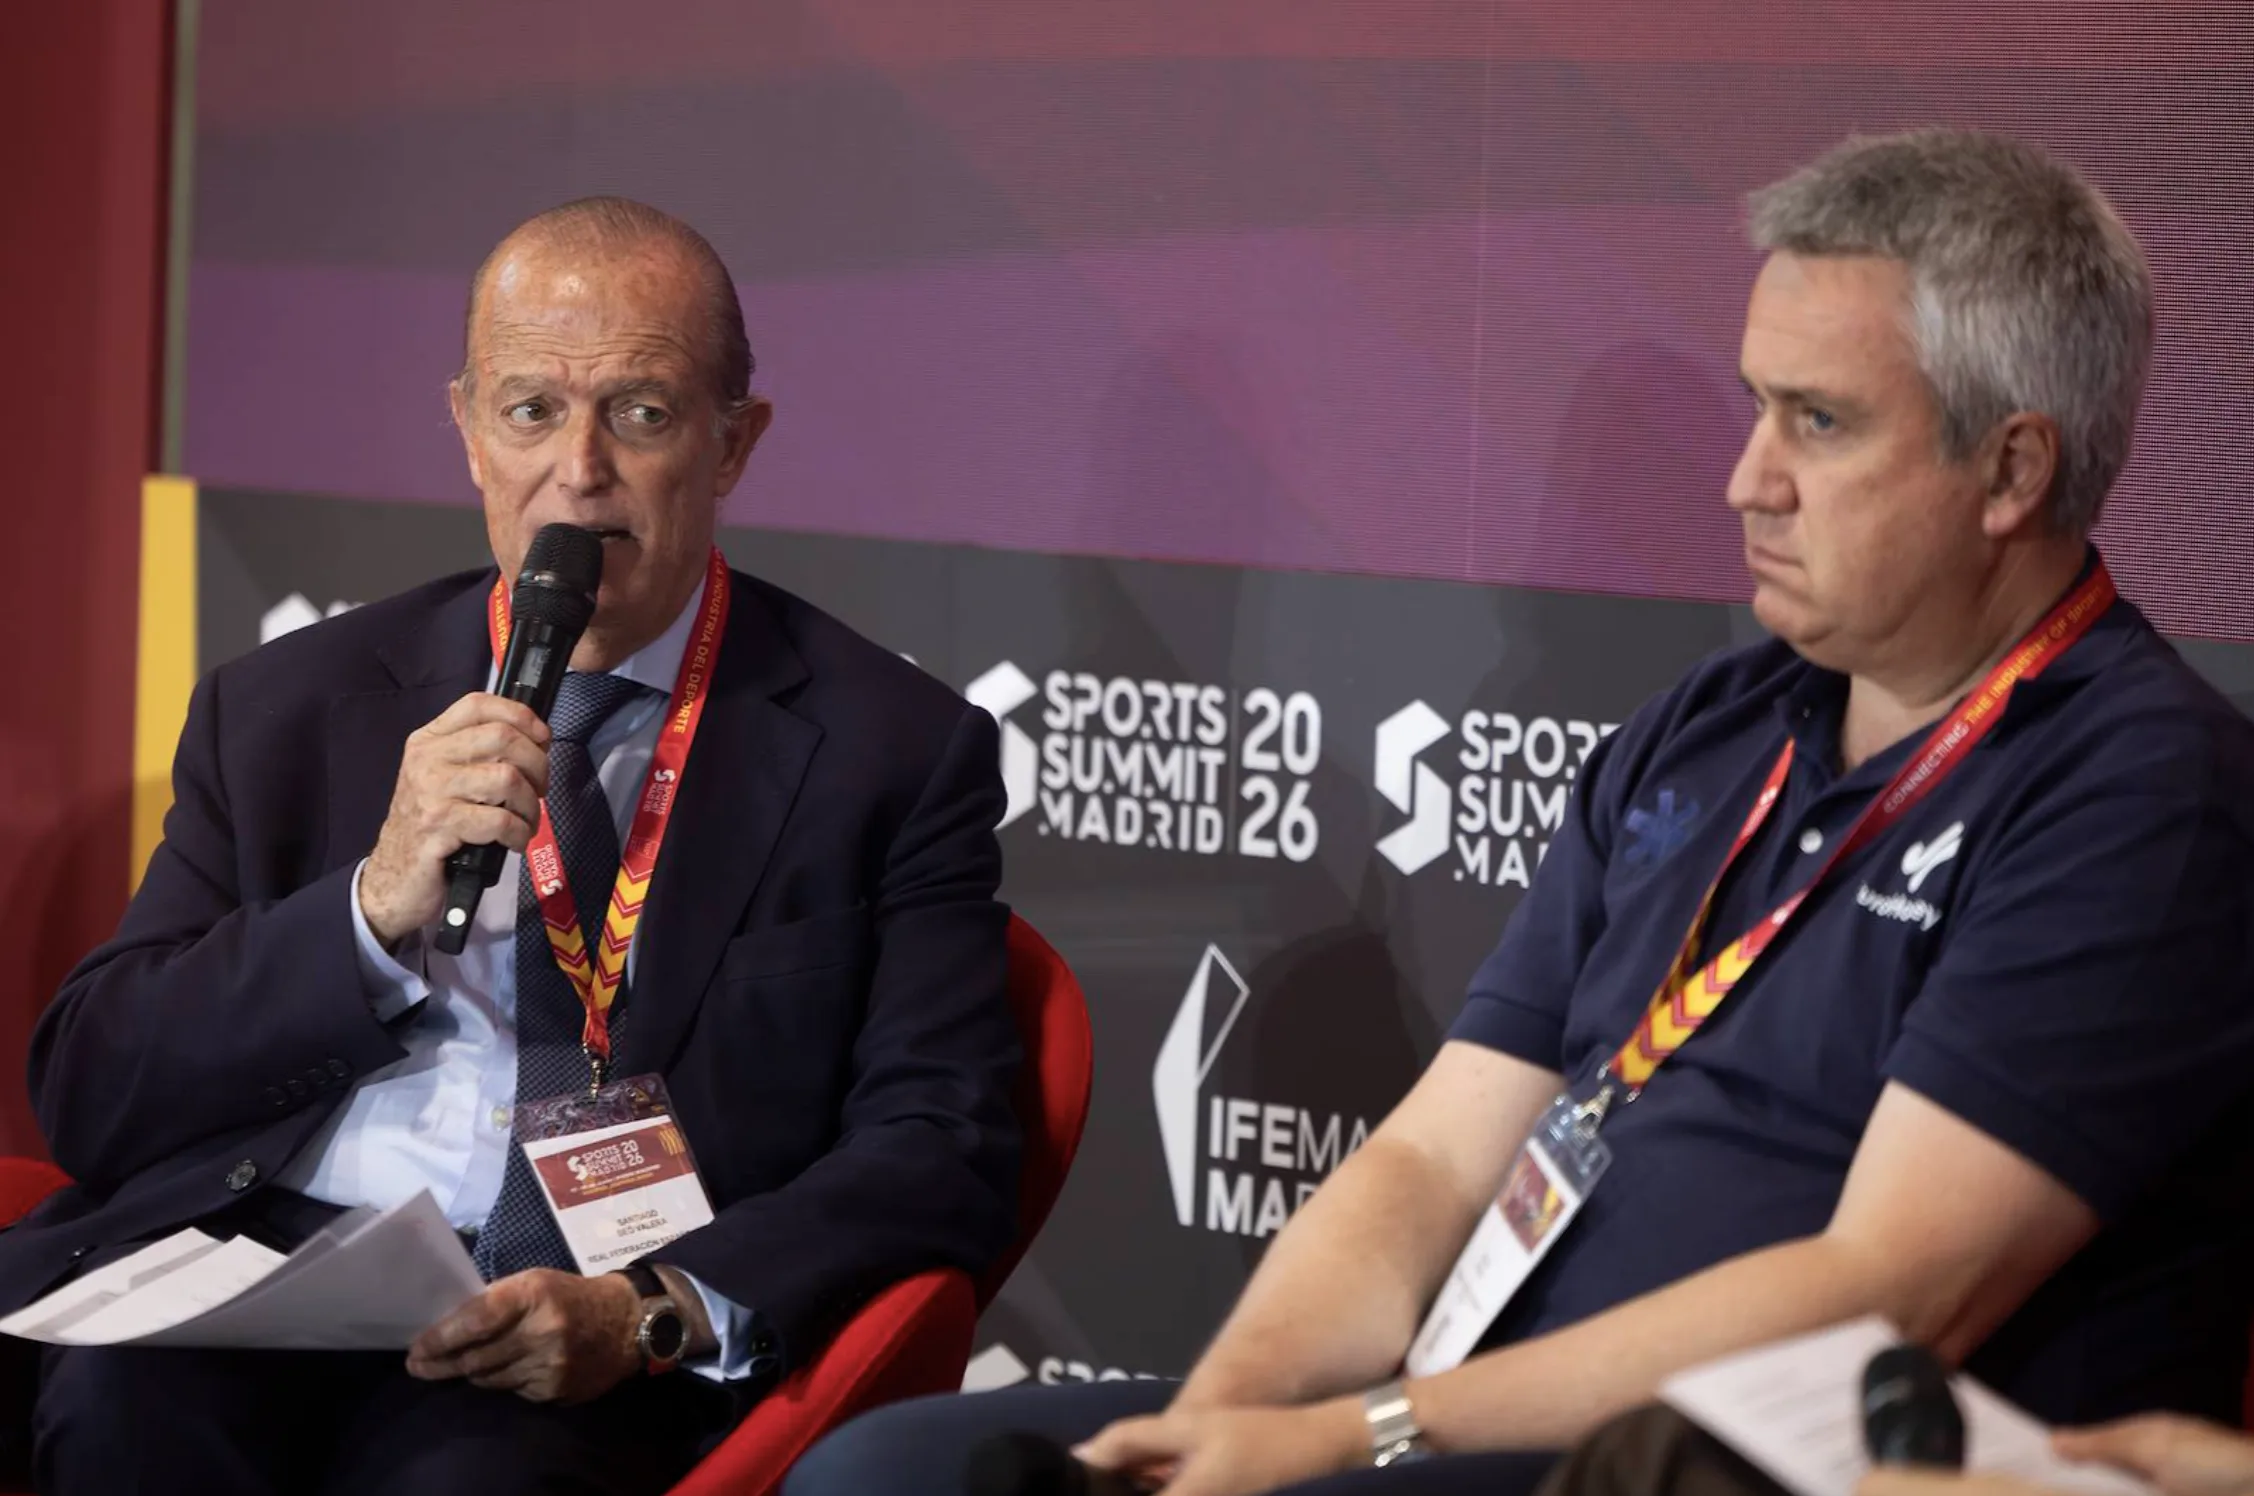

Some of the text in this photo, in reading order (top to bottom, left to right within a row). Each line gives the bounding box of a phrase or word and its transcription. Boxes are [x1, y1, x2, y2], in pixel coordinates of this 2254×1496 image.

[700, 578, 724, 643] INDUSTRIA
[691, 644, 710, 674] DEL
[673, 671, 702, 735] DEPORTE
[1042, 669, 1228, 746] SPORTS
[1242, 687, 1322, 776] 20
[1884, 721, 1970, 814] CONNECTING
[1964, 697, 1994, 726] THE
[1990, 635, 2050, 699] INDUSTRY
[2049, 619, 2069, 641] OF
[1040, 731, 1227, 806] SUMMIT
[1458, 709, 1623, 780] SPOR
[1038, 788, 1225, 856] MADRID
[1239, 775, 1319, 863] 26
[1456, 774, 1575, 839] SUM
[1453, 833, 1550, 890] MA
[620, 1139, 639, 1155] 20
[625, 1152, 645, 1167] 26
[1206, 1167, 1320, 1238] MA
